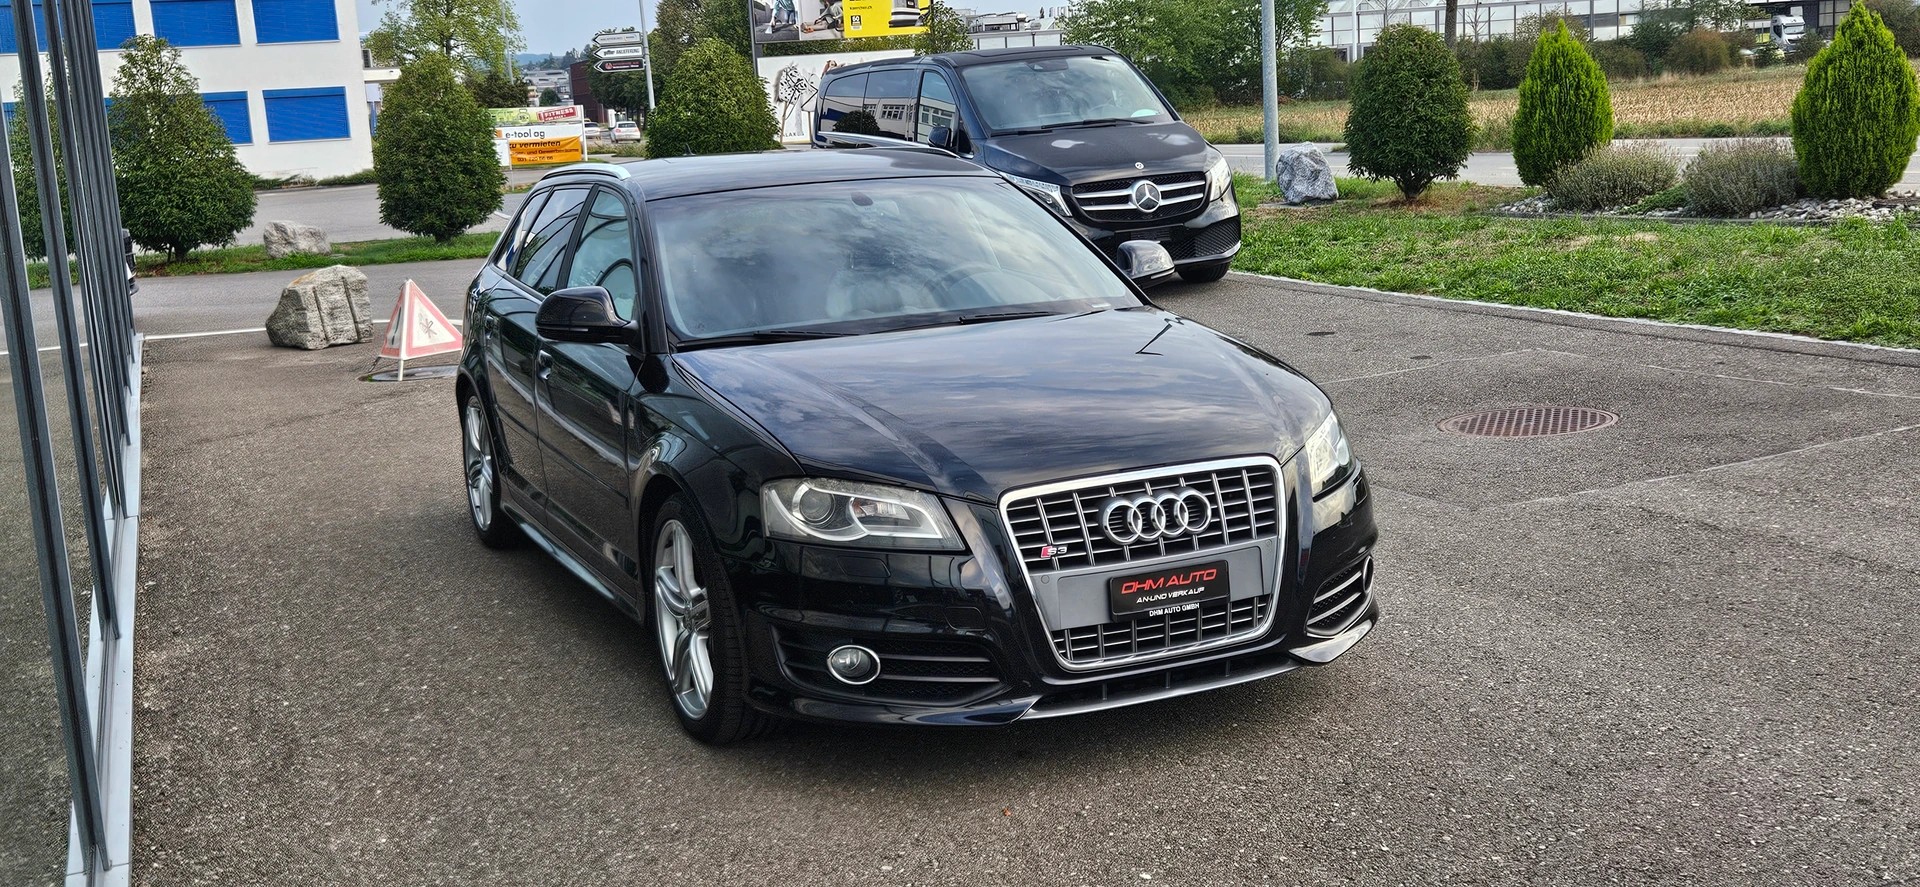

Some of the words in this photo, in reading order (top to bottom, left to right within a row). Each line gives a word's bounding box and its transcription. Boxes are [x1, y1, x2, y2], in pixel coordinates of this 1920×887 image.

[544, 106, 574, 118] FITNESS
[505, 128, 532, 139] e-tool
[519, 140, 561, 149] vermieten
[1045, 546, 1068, 556] S3
[1120, 577, 1164, 595] DHM
[1166, 568, 1217, 587] AUTO
[1135, 593, 1167, 604] AN-UND
[1167, 586, 1205, 599] VERKAUF
[1149, 608, 1164, 617] DHM
[1164, 605, 1181, 615] AUTO
[1181, 603, 1200, 612] GMBH
